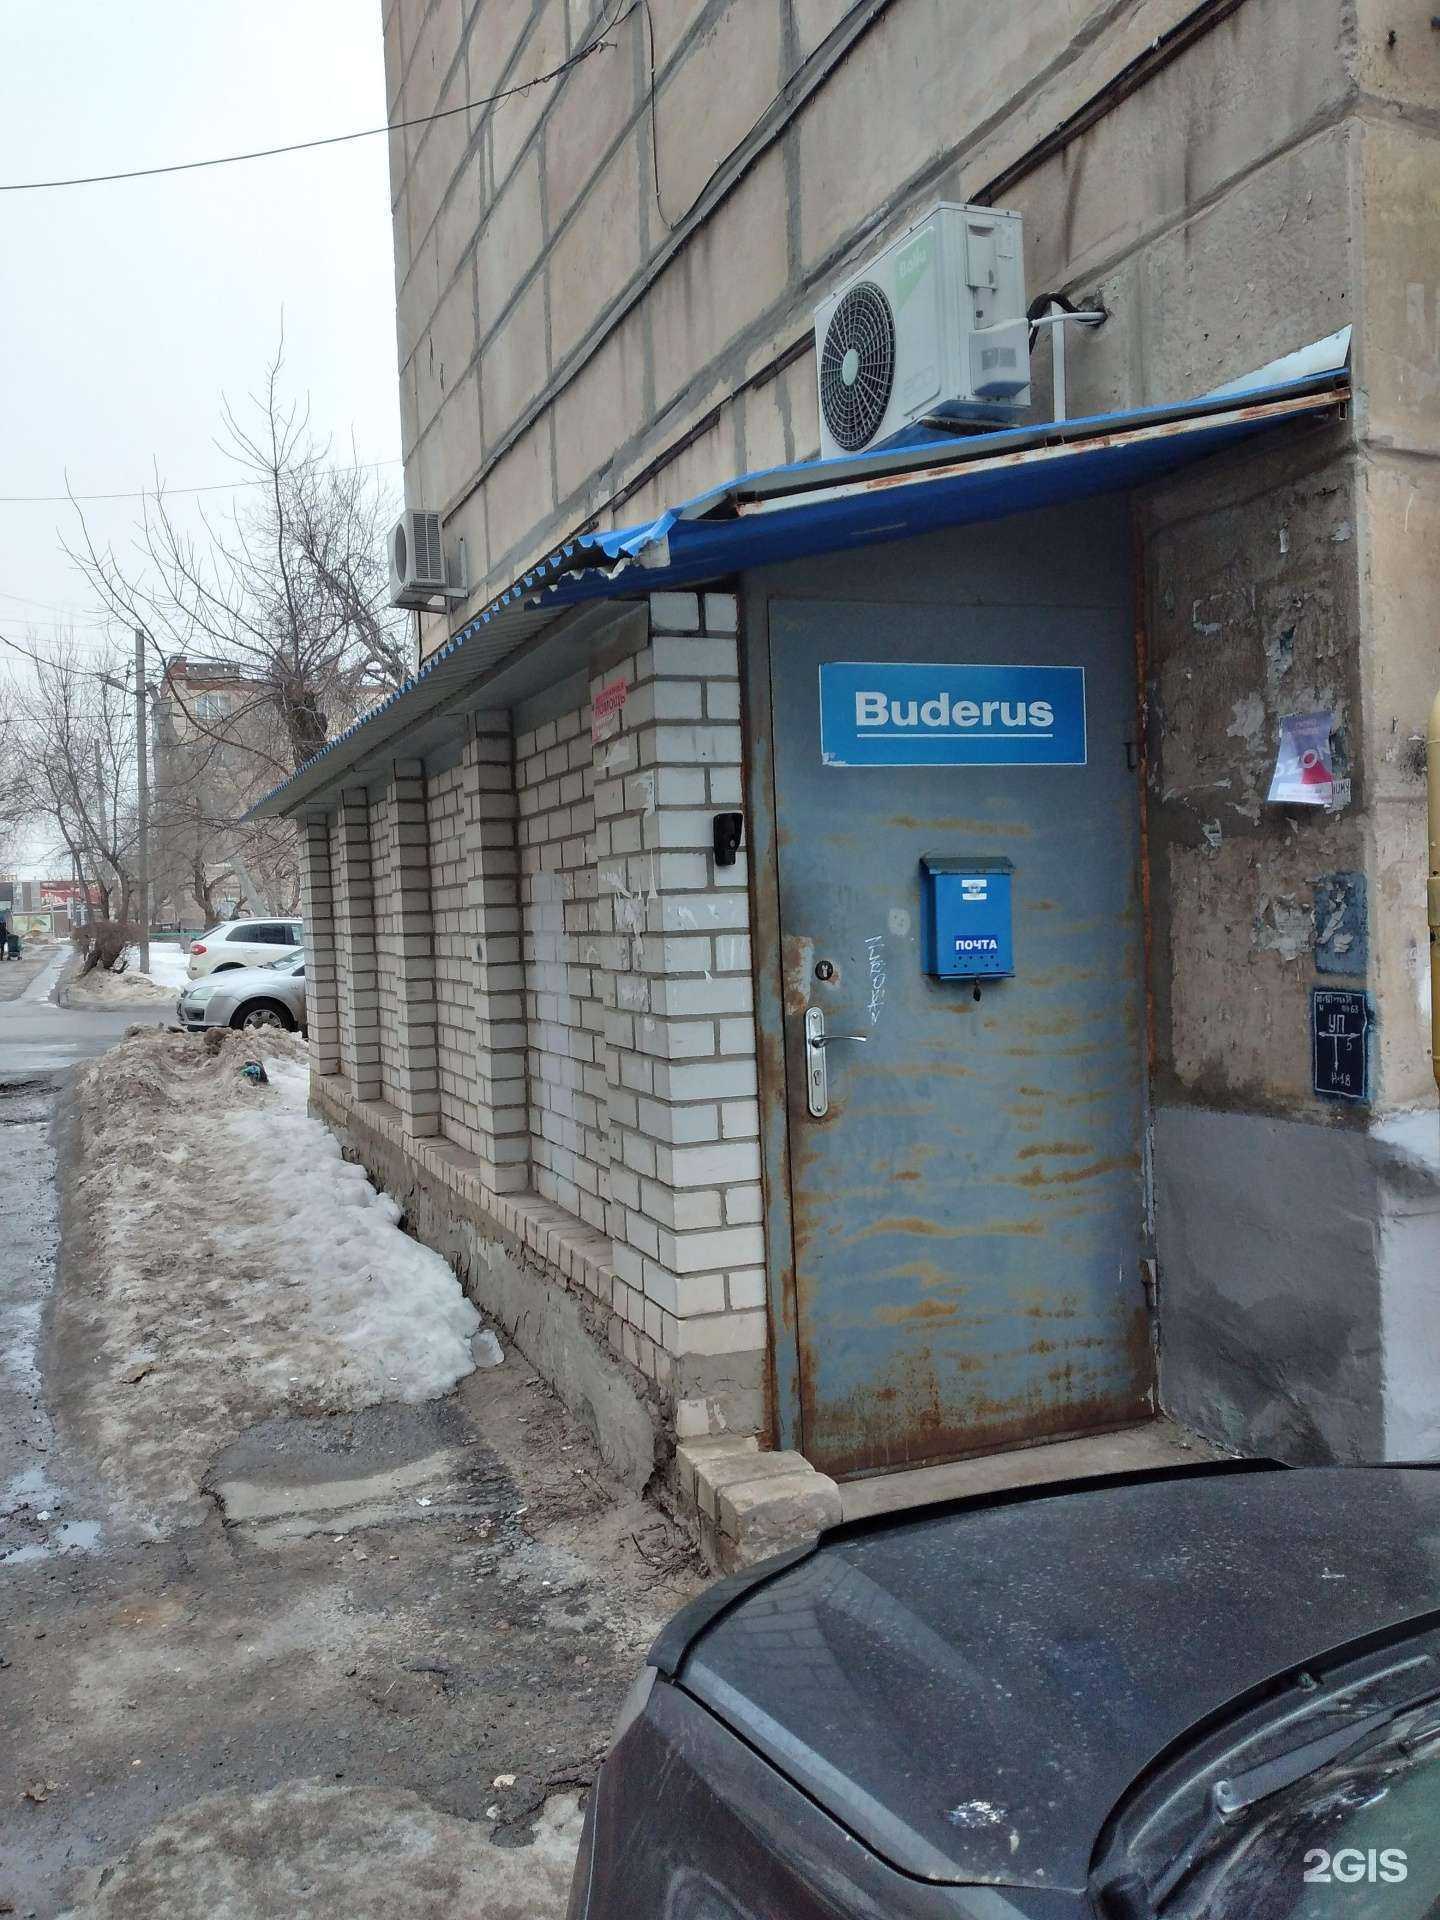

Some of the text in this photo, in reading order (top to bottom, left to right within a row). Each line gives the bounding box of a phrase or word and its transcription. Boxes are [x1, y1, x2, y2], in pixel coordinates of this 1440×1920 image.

[855, 691, 1055, 727] Buderus
[955, 939, 998, 951] ПОЧТА
[1328, 1014, 1345, 1034] УП
